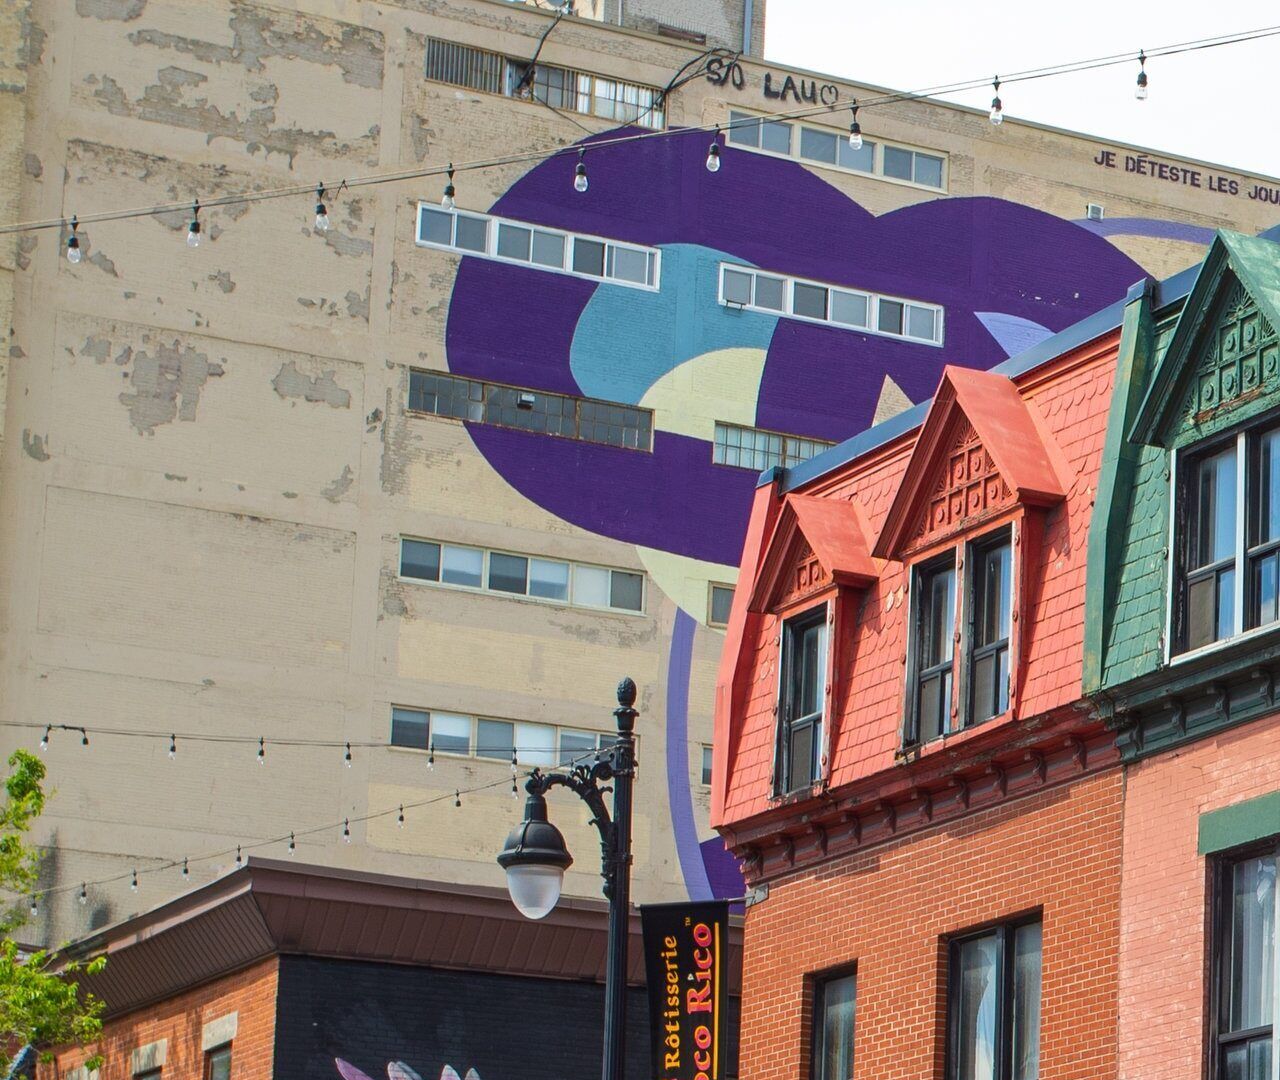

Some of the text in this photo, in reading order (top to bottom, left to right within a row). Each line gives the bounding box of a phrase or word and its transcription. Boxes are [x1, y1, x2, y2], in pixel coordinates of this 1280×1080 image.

[764, 71, 817, 104] LAU
[1094, 150, 1116, 167] JE
[1125, 154, 1201, 188] DÉTESTE
[1208, 175, 1238, 195] LES
[663, 935, 680, 1071] Rôtisserie
[686, 922, 713, 1016] Rico
